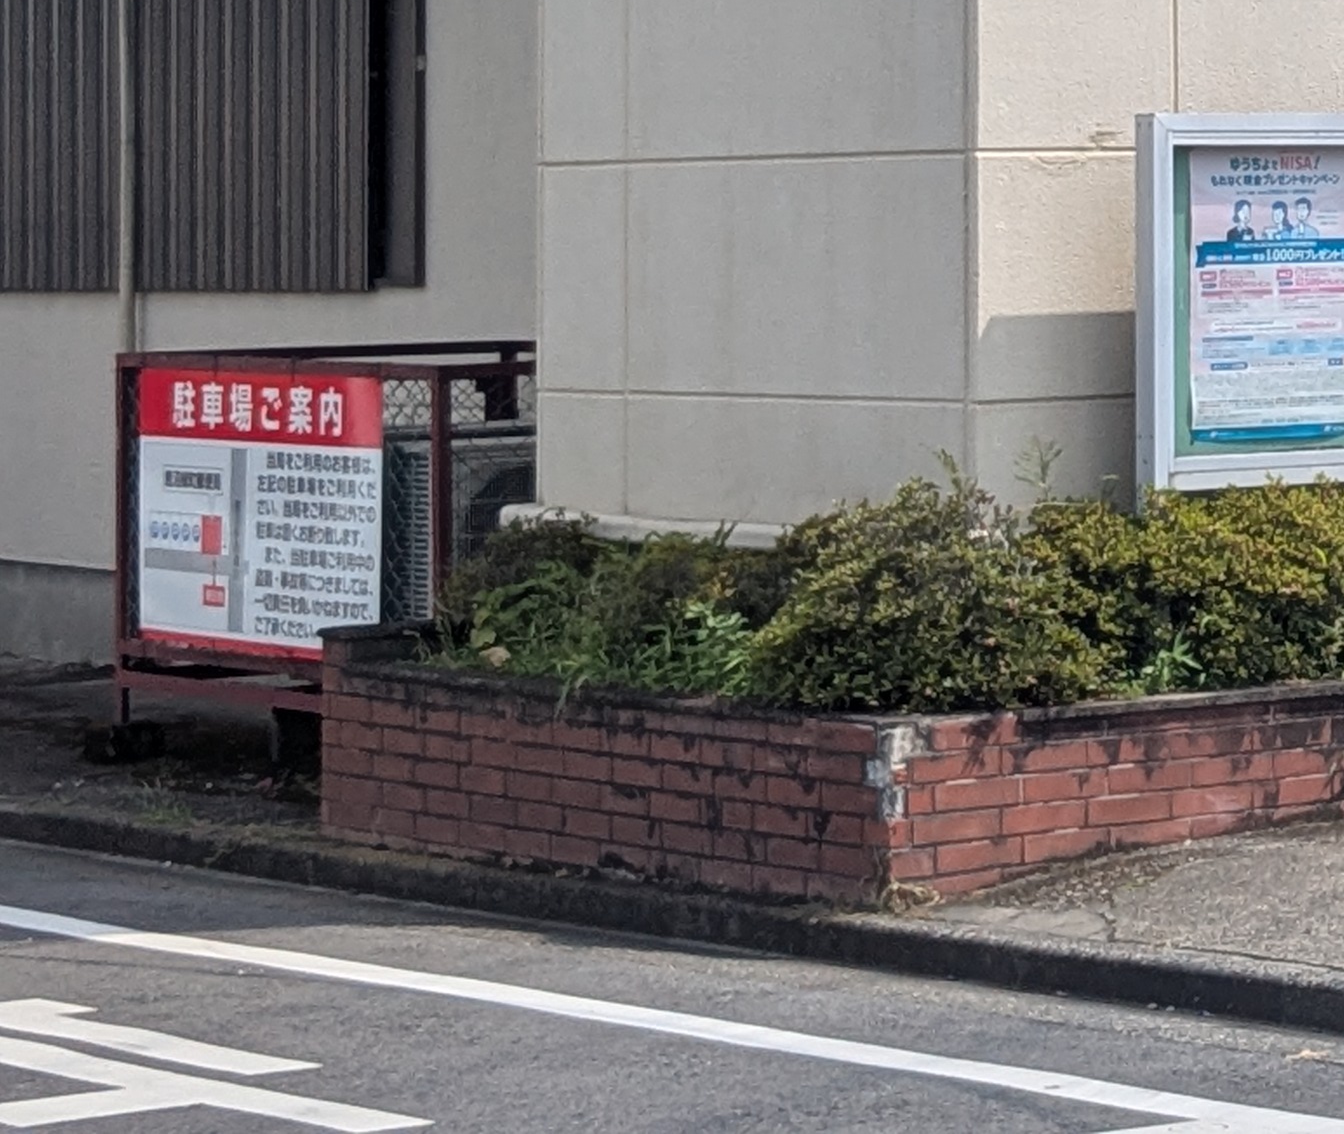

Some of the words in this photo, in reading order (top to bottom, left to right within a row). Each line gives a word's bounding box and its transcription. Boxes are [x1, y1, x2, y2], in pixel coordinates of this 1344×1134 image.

[171, 380, 344, 438] 駐車場ご案内
